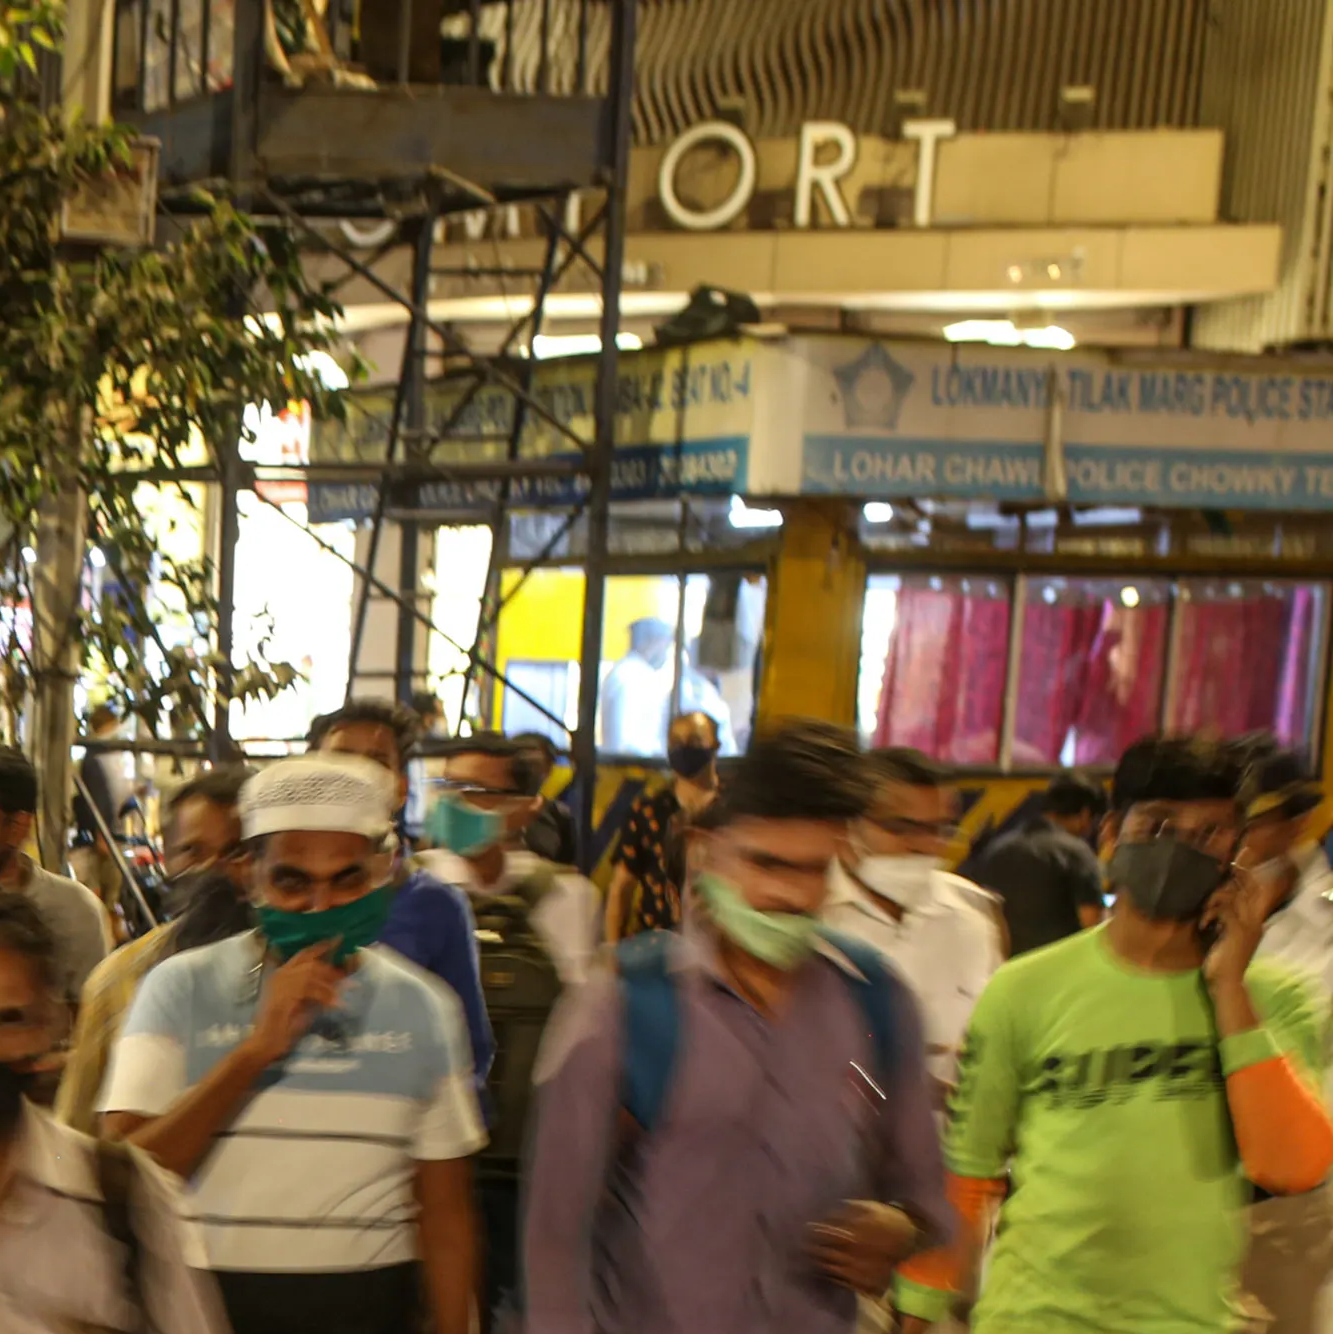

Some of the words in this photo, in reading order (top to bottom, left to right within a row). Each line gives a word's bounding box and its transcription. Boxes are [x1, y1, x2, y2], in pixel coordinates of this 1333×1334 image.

[931, 363, 1057, 409] LOKMANY
[1066, 367, 1133, 414] TILAK
[1138, 370, 1206, 418] MARG
[833, 450, 937, 485] LOHAR
[1169, 462, 1298, 496] CHOWKY
